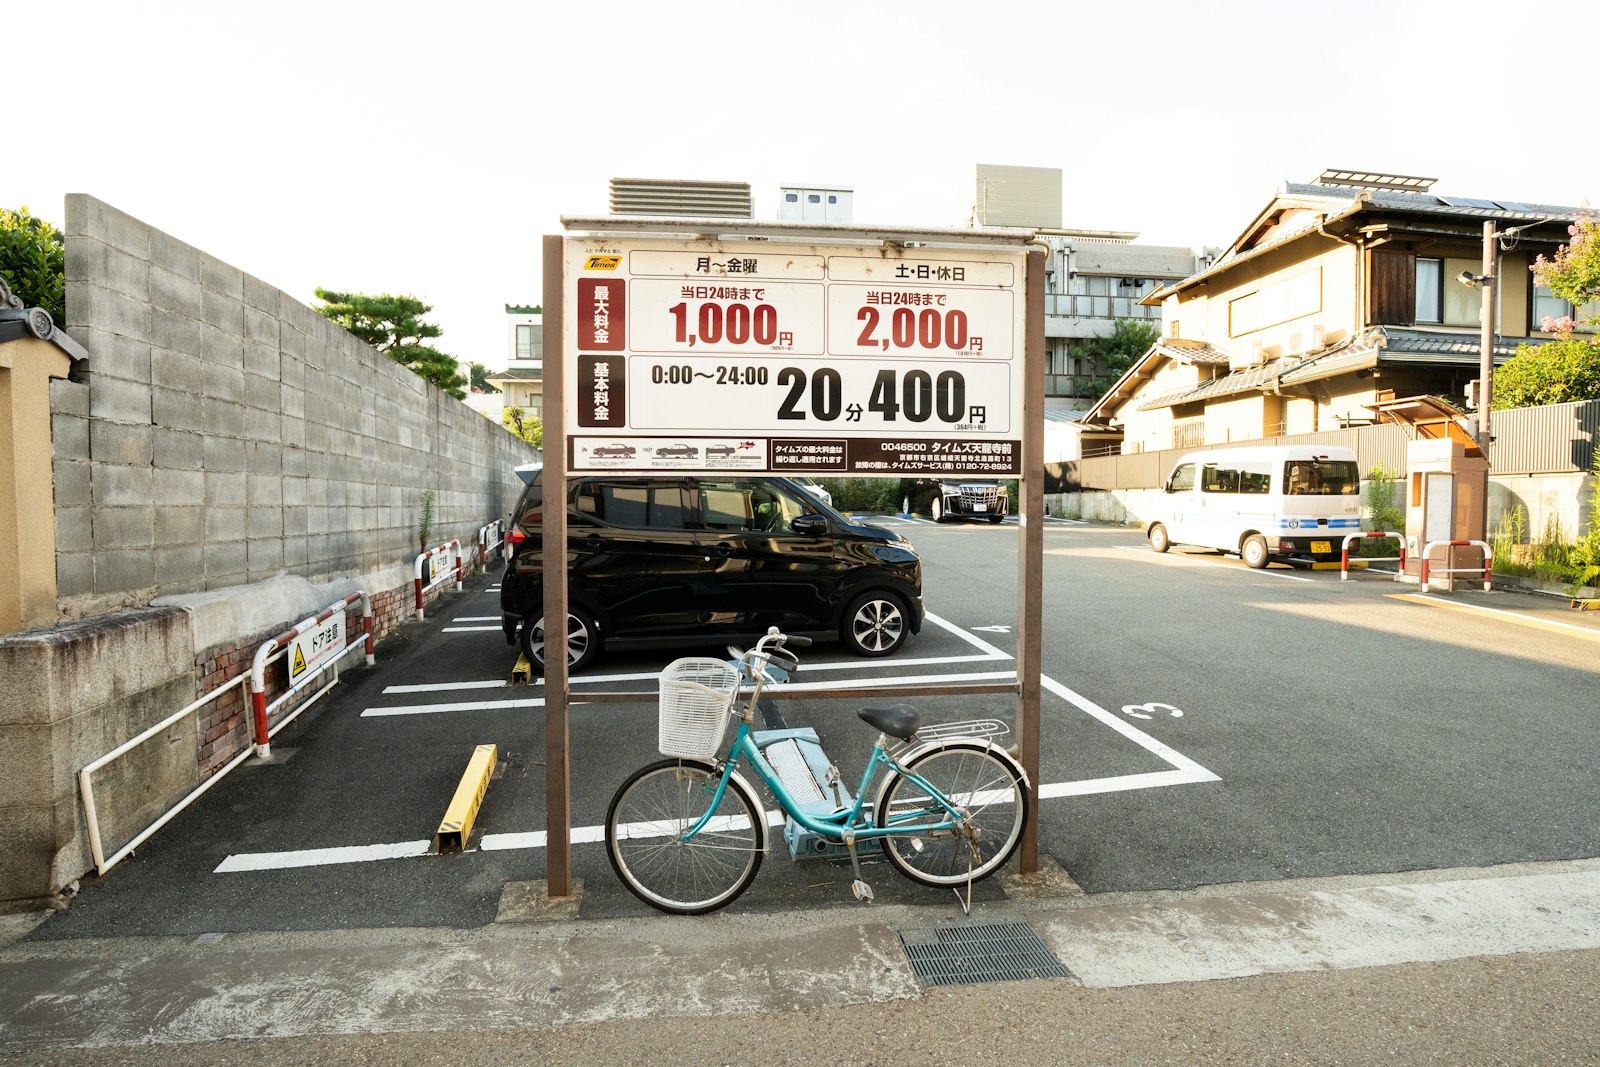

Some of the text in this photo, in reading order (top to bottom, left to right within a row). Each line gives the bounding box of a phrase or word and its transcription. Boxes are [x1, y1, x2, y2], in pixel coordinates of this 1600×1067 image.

[590, 258, 618, 268] Times
[681, 286, 765, 301] 当日24時まで
[866, 291, 947, 306] 当日24時まで
[594, 285, 609, 344] 最大料金
[594, 362, 609, 421] 基本料金
[775, 445, 843, 454] タイムズの最大料金は
[881, 442, 1012, 454] 0046500 タイムズ天龍寺前
[955, 463, 1012, 471] 0120-72-8924
[971, 625, 1012, 633] 4
[312, 623, 338, 653] ドア注意
[1121, 702, 1184, 720] 3
